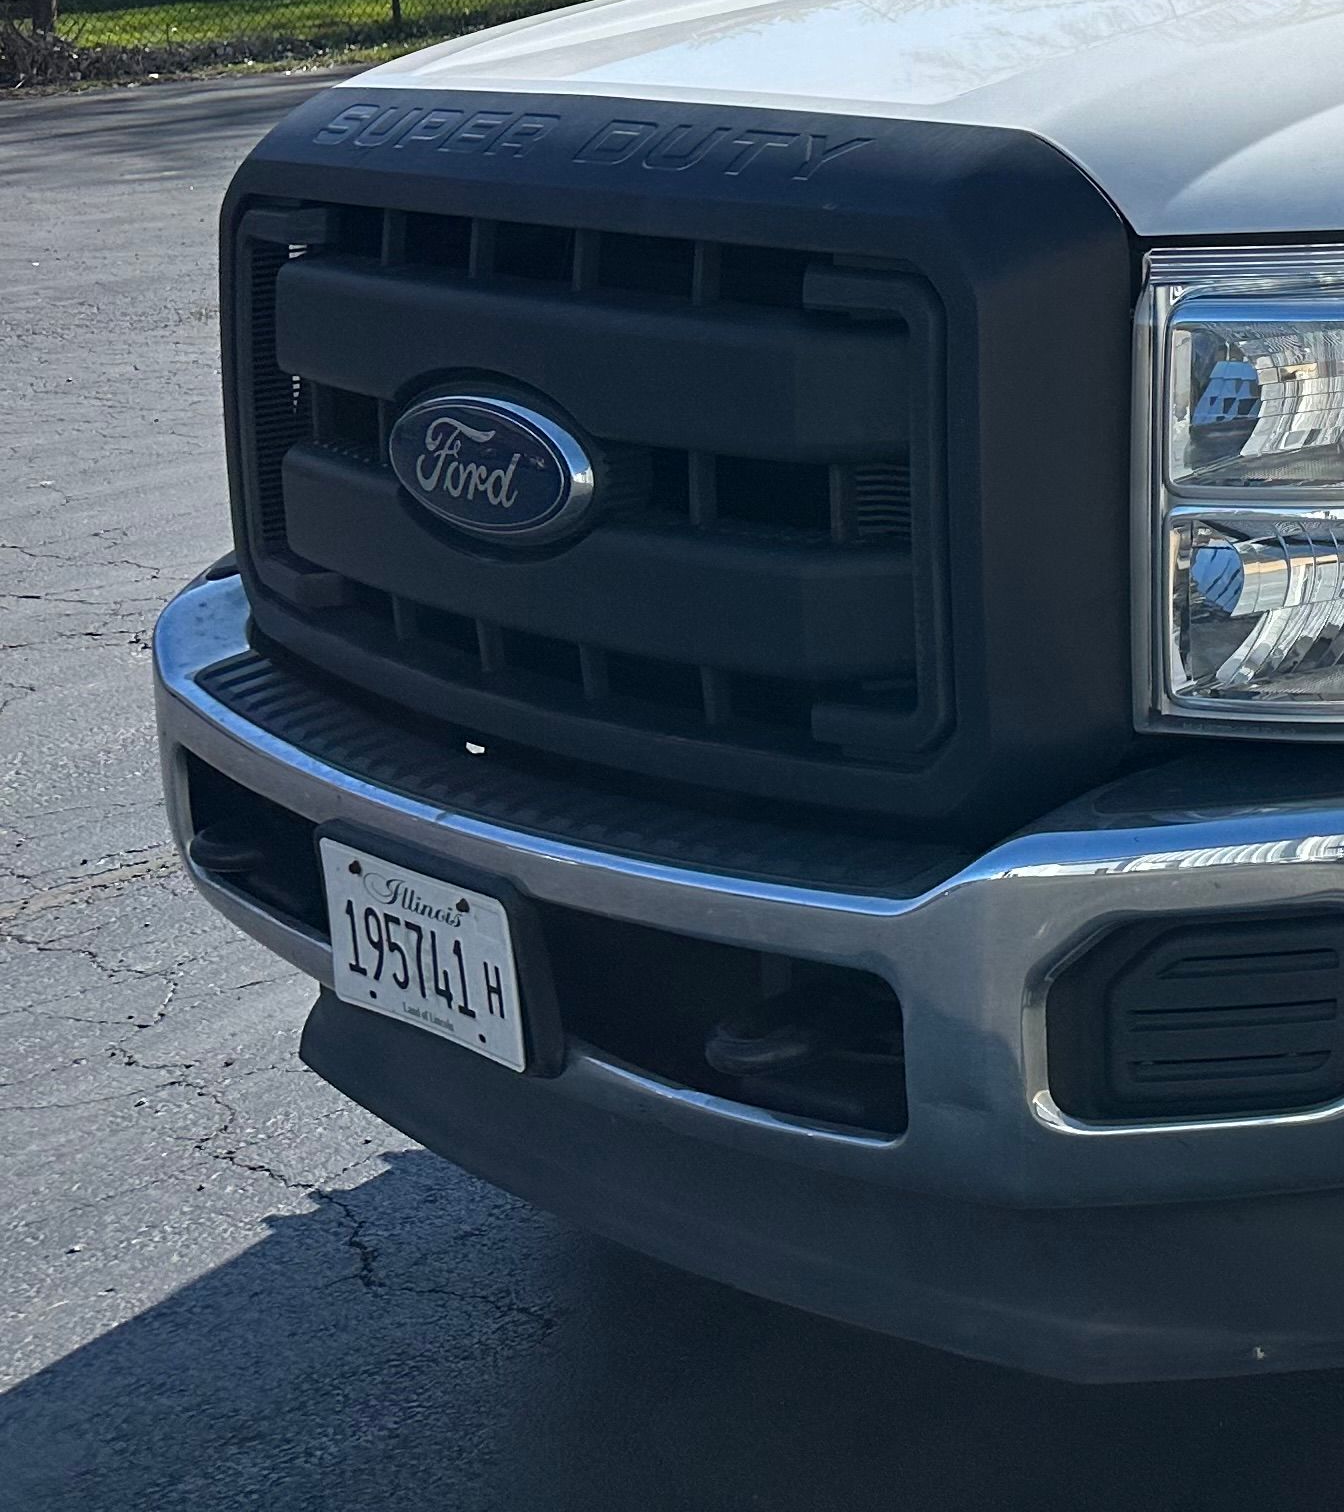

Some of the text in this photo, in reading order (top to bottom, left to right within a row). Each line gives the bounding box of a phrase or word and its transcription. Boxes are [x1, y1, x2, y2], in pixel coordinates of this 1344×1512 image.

[313, 103, 877, 181] SUPER DUTY
[416, 417, 521, 508] Ford
[363, 872, 463, 928] Illinois
[345, 899, 506, 1020] 195741 H
